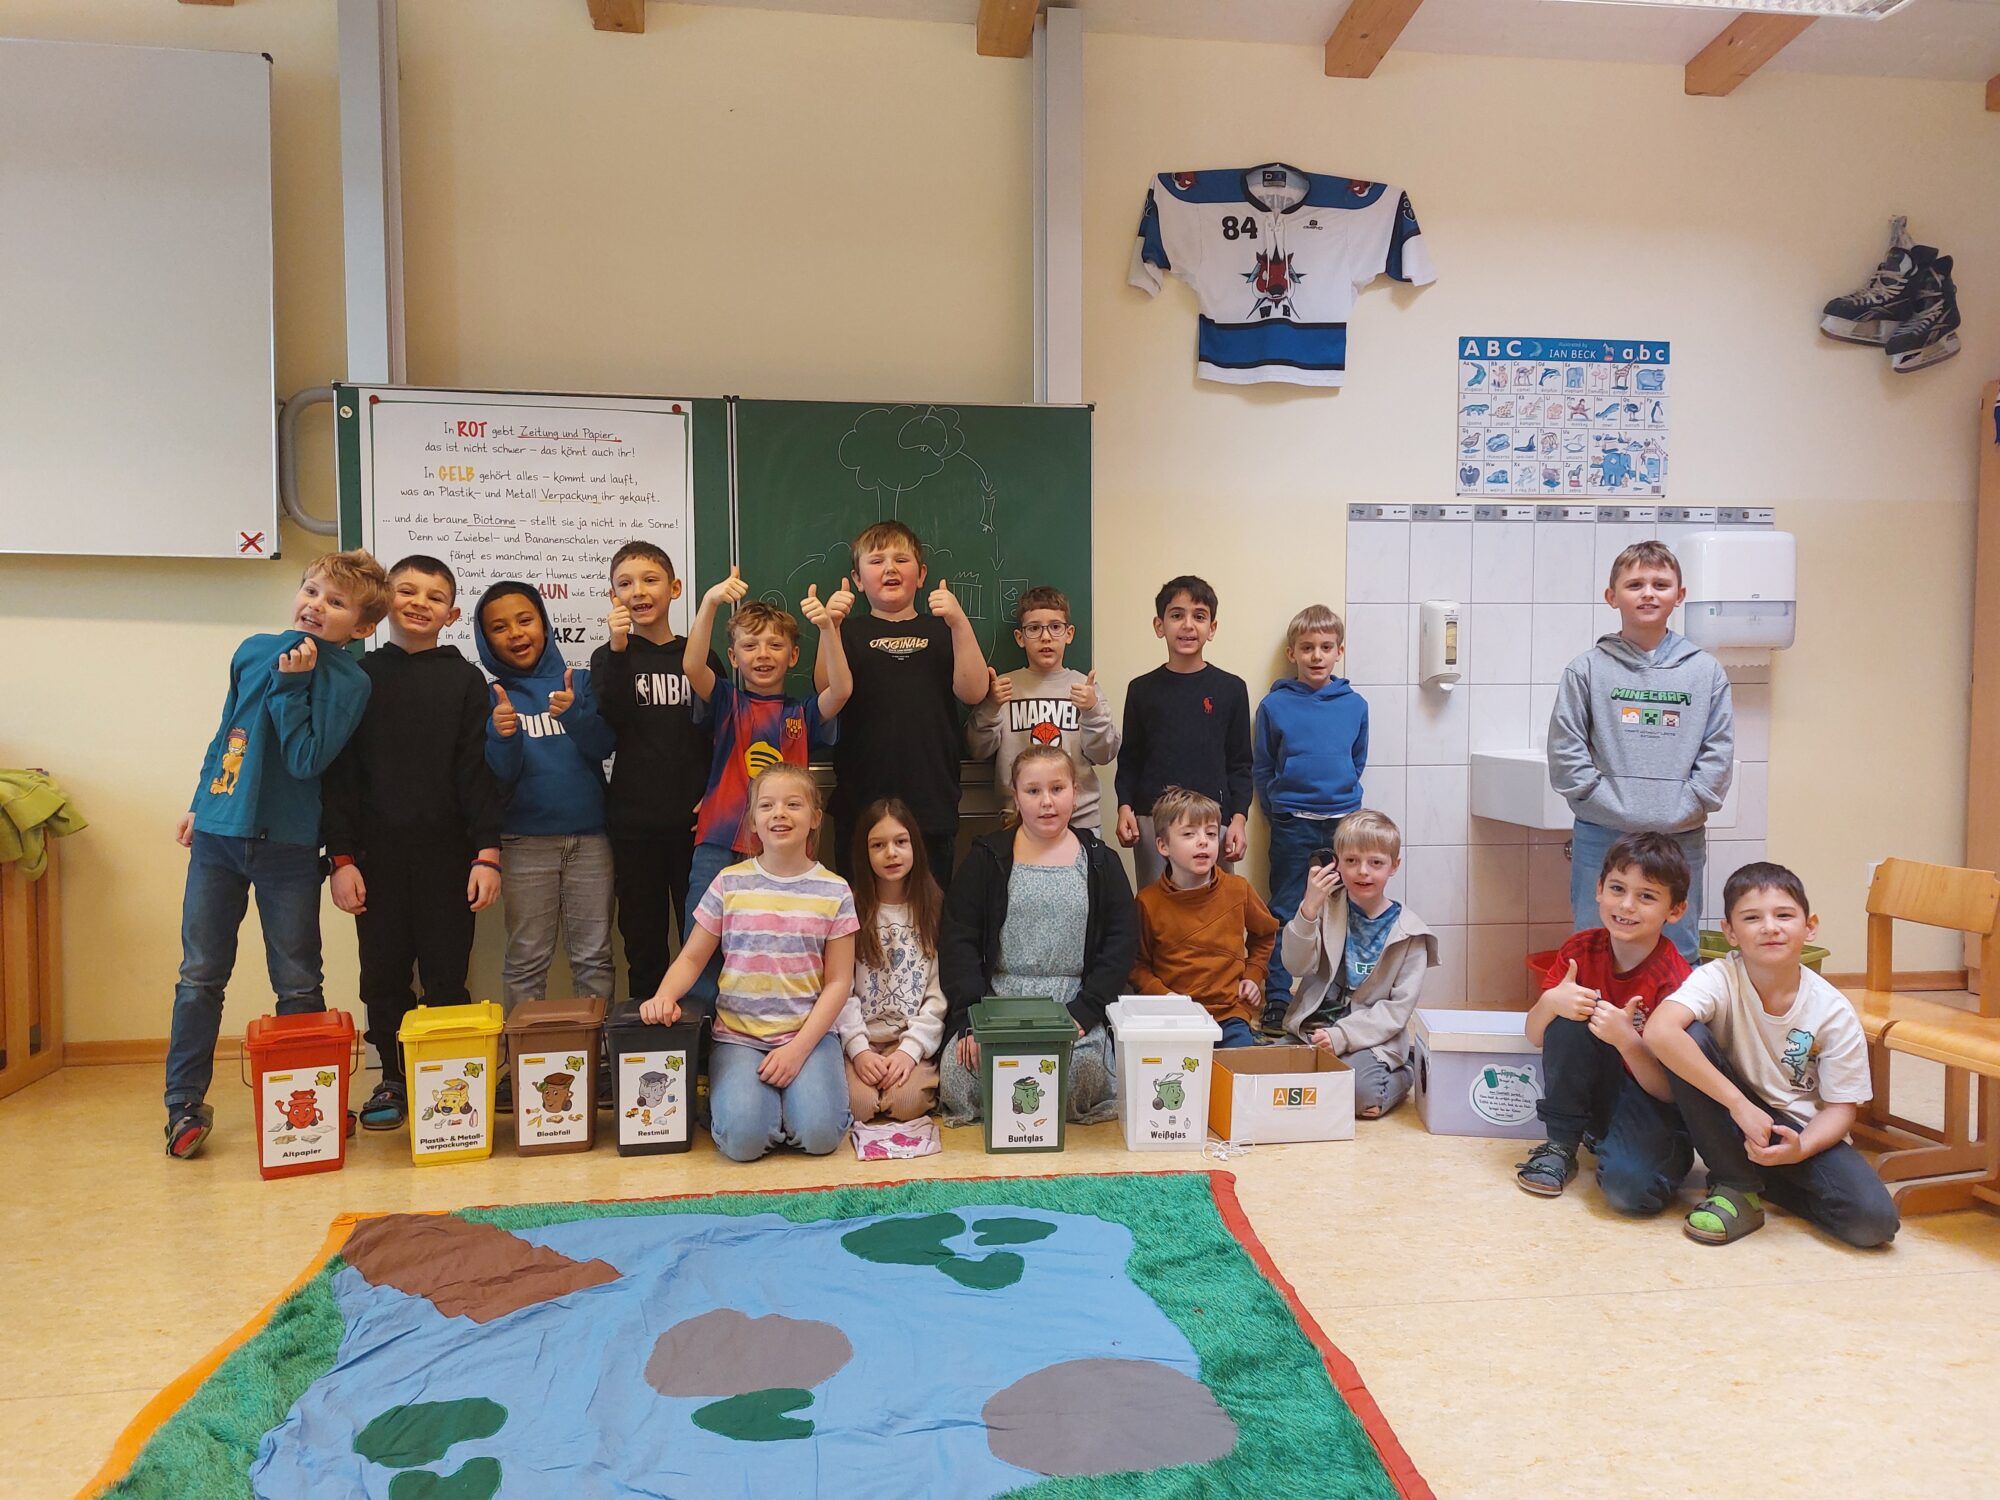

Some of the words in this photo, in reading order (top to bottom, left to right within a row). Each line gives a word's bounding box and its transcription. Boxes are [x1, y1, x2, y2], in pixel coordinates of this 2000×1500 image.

[1222, 216, 1258, 240] 84
[1464, 340, 1480, 356] A
[1487, 340, 1500, 356] B
[1506, 340, 1522, 357] C
[1550, 349, 1568, 358] IAN
[1572, 350, 1596, 359] BECK
[1622, 348, 1634, 360] a
[1640, 344, 1650, 360] b
[1655, 349, 1664, 360] c
[444, 422, 454, 434] In
[457, 420, 488, 438] ROT
[492, 425, 514, 438] gebt
[520, 426, 558, 440] Zeitung
[562, 429, 578, 438] und
[582, 428, 618, 442] Papier,
[424, 442, 442, 452] das
[446, 442, 459, 452] ist
[464, 442, 488, 452] nicht
[492, 443, 526, 454] schwer
[540, 446, 558, 455] das
[561, 446, 588, 458] könnt
[592, 448, 614, 457] auch
[618, 448, 636, 458] ihr!
[424, 466, 434, 478] In
[438, 464, 475, 482] GELB
[480, 469, 512, 483] gehört
[516, 470, 538, 481] alles
[553, 472, 586, 484] kommt
[590, 474, 606, 484] und
[422, 488, 434, 496] an
[485, 488, 501, 498] und
[506, 488, 537, 499] Metall
[540, 488, 598, 504] Verpackung
[601, 490, 615, 501] ihr
[619, 492, 661, 504] gekauft.
[394, 513, 411, 523] und
[415, 513, 428, 523] die
[433, 513, 468, 524] braune
[473, 513, 516, 526] Biotonne
[530, 516, 556, 526] stellt
[562, 518, 574, 527] sie
[576, 517, 588, 530] ja
[591, 517, 614, 528] nicht
[620, 518, 627, 528] in
[630, 518, 644, 528] die
[648, 518, 678, 529] Sonne!
[408, 530, 434, 542] Denn
[504, 532, 520, 543] und
[524, 532, 598, 545] Bananenschalen
[450, 550, 476, 563] fängt
[496, 550, 542, 561] manchmal
[562, 554, 574, 562] zu
[457, 567, 488, 578] Damit
[490, 568, 524, 579] daraus
[526, 570, 542, 579] der
[546, 568, 578, 580] Humus
[470, 585, 482, 596] die
[572, 588, 586, 597] wie
[553, 613, 582, 624] bleibt
[446, 630, 454, 640] in
[458, 630, 470, 640] die
[590, 632, 604, 640] wie
[869, 638, 928, 650] ORIGINALS
[652, 674, 692, 706] NBA
[1610, 688, 1692, 706] MINECRAFT
[1010, 699, 1080, 730] MARVEL
[426, 1140, 478, 1150] verpackungen
[1008, 1134, 1044, 1144] Buntglas
[282, 1148, 322, 1158] Altpapier
